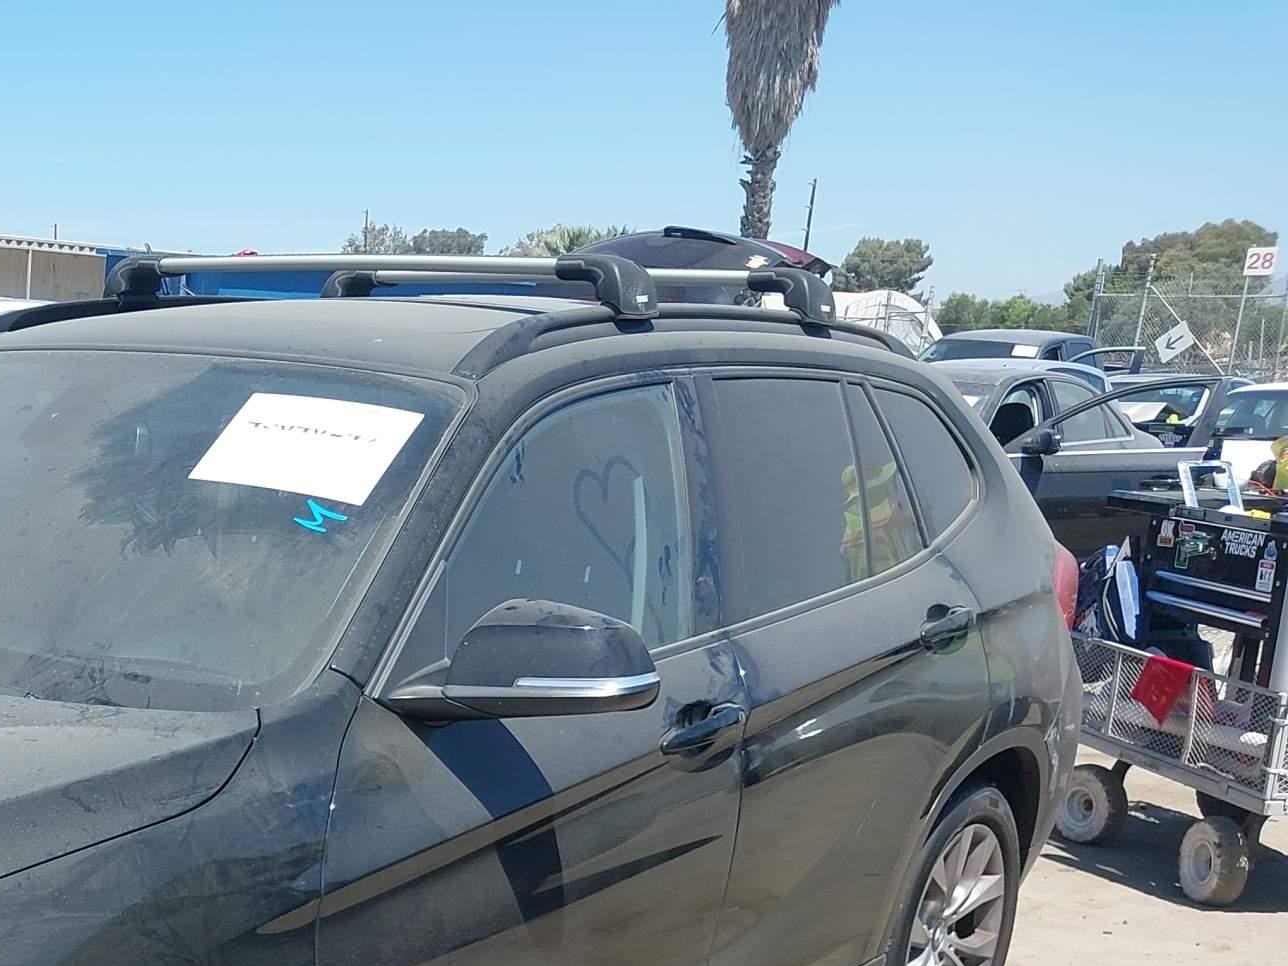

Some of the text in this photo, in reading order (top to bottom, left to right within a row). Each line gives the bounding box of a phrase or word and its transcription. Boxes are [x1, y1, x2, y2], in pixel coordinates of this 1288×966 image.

[1247, 252, 1274, 270] 28
[1221, 528, 1266, 547] AMERICAN
[1224, 541, 1257, 559] TRUCKS
